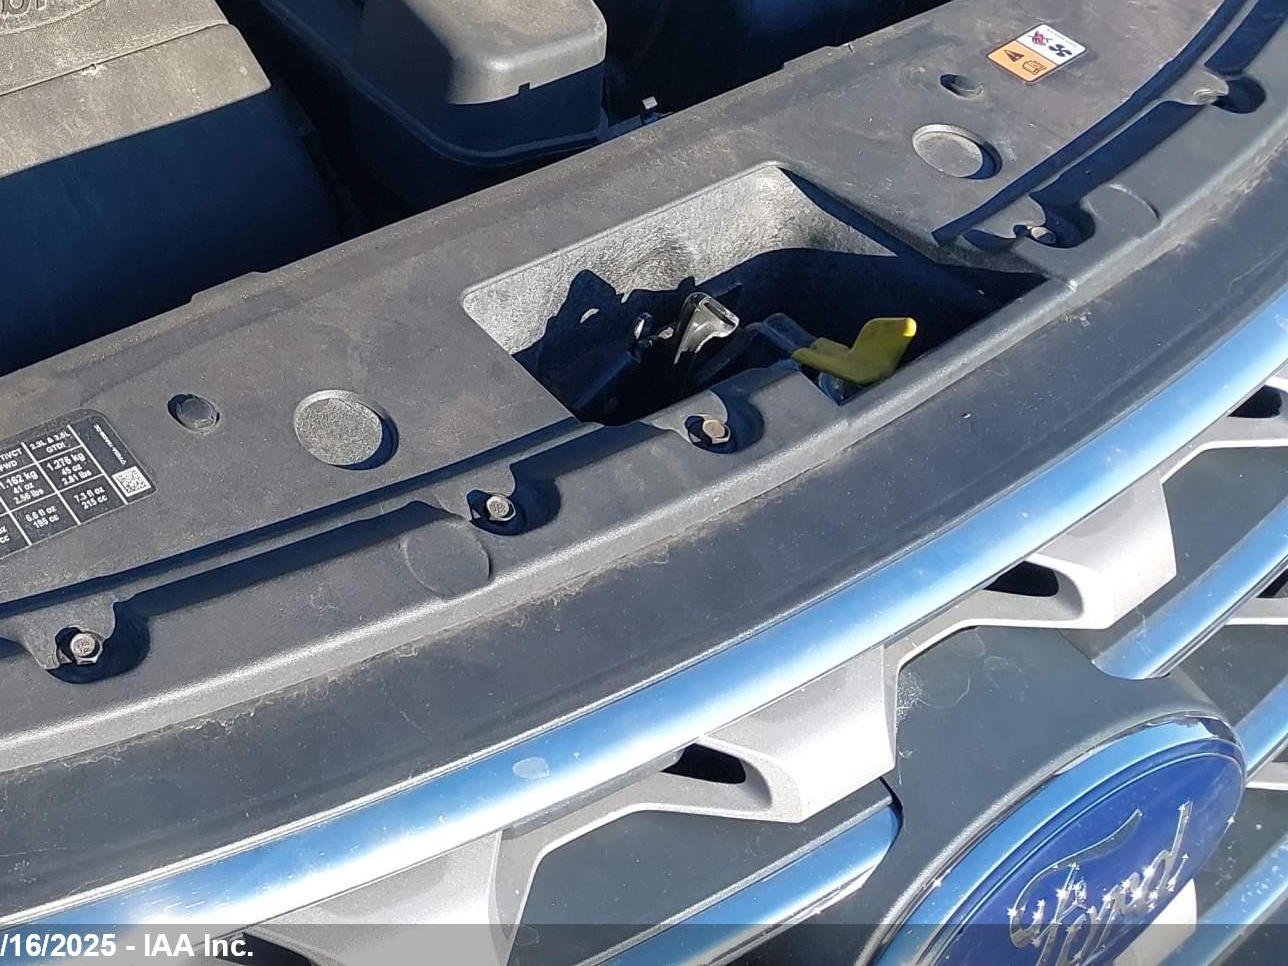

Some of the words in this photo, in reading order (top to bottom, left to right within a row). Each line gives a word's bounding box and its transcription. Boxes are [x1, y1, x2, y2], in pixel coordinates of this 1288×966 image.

[45, 441, 66, 453] GTDI
[46, 456, 72, 471] 1.276
[71, 452, 86, 462] kg
[23, 470, 39, 480] kg
[61, 467, 72, 475] 45
[71, 463, 83, 471] oz
[78, 470, 92, 479] lbs
[13, 485, 24, 494] 41
[23, 482, 35, 490] oz
[87, 489, 95, 498] fl
[94, 486, 106, 495] oz
[13, 492, 31, 505] 2.56
[30, 488, 44, 497] lbs
[81, 498, 97, 510] 215
[97, 495, 108, 503] cc
[38, 508, 46, 517] fl
[46, 505, 57, 514] oz
[33, 517, 49, 529] 195
[48, 514, 60, 523] cc
[1008, 800, 1194, 966] Ford
